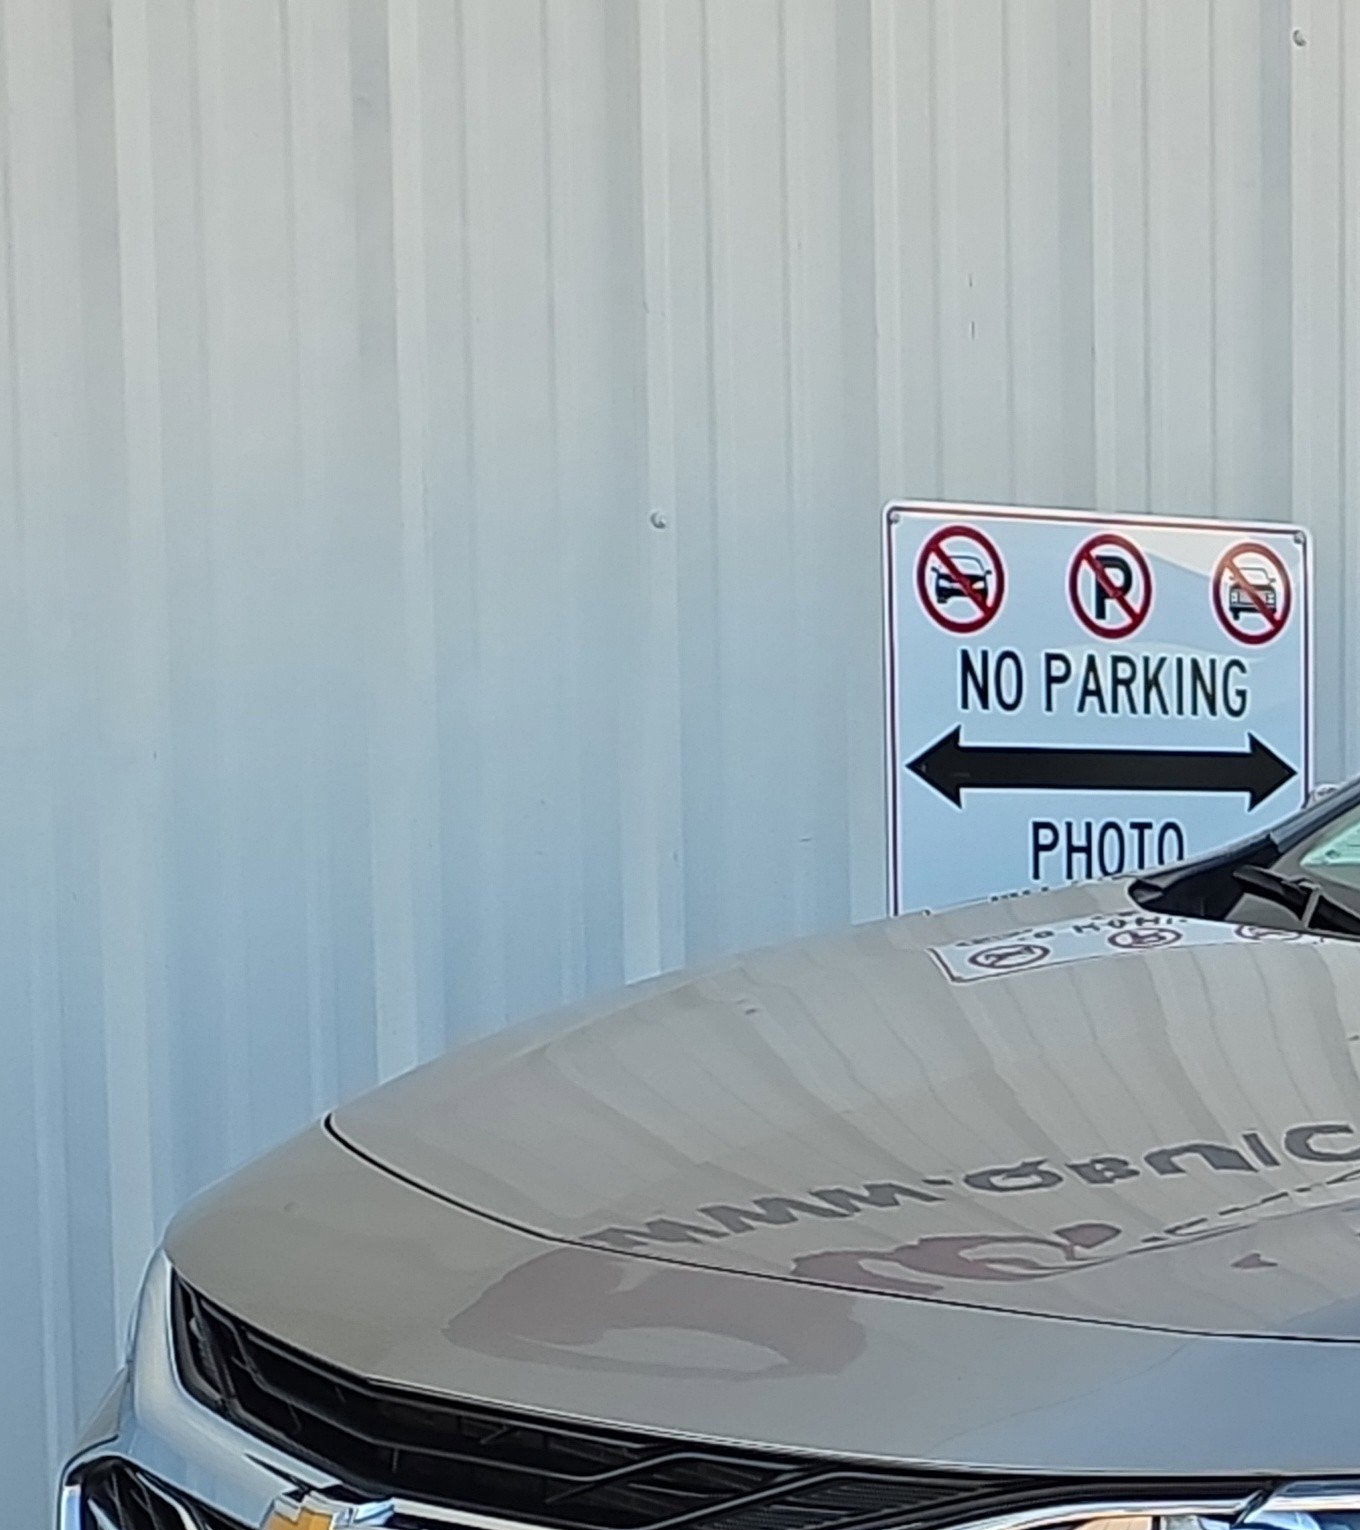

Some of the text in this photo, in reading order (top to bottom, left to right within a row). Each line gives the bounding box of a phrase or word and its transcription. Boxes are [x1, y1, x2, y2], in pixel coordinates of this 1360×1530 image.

[959, 649, 1249, 718] NO PARKING
[1031, 821, 1185, 880] PHOTO
